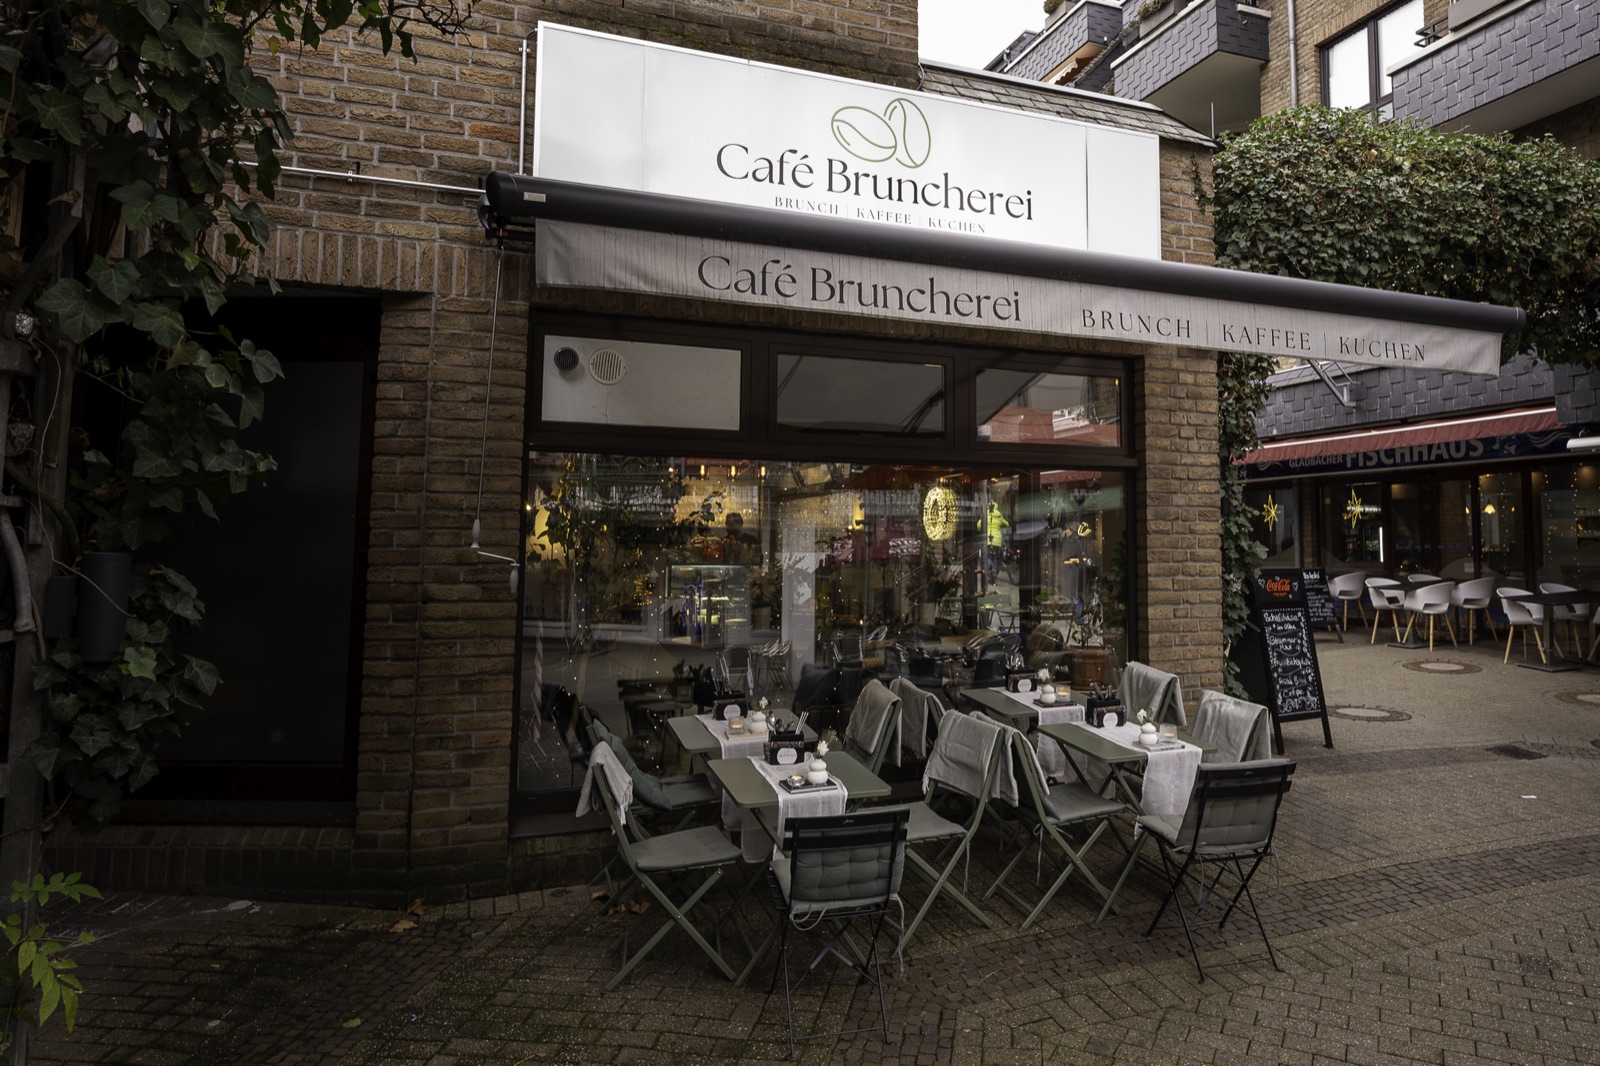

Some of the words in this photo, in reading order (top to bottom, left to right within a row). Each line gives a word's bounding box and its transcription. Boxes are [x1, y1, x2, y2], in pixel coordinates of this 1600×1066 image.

[716, 143, 814, 189] Café
[826, 158, 1033, 221] Bruncherei
[775, 196, 838, 215] BRUNCH
[857, 207, 912, 225] KAFFEE
[928, 217, 986, 234] KUCHEN
[697, 255, 798, 298] Café
[810, 266, 1021, 322] Bruncherei
[1082, 308, 1191, 338] BRUNCH
[1222, 323, 1311, 352] KAFFEE
[1339, 335, 1426, 362] KUCHEN
[1289, 454, 1343, 469] GLADBACHER
[1346, 438, 1485, 468] FISCHHAUS
